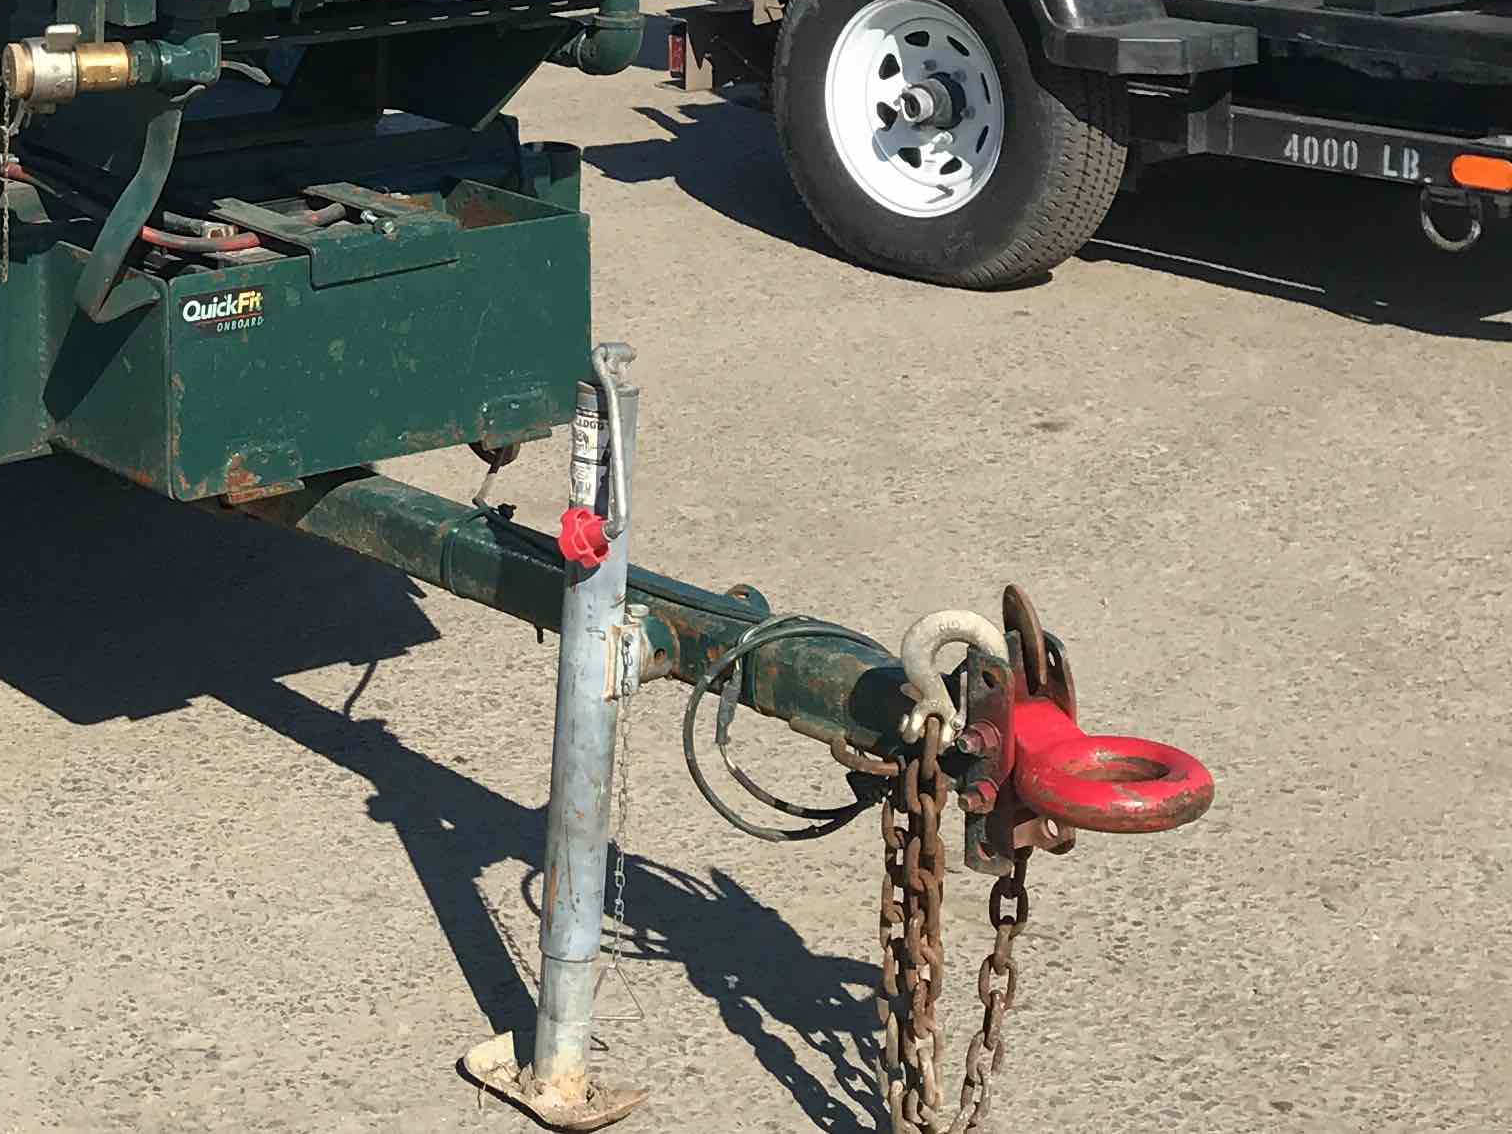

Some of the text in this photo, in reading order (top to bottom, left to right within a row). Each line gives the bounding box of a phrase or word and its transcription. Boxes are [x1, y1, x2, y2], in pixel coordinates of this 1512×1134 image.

[1284, 133, 1433, 184] 4000 LB.
[182, 290, 264, 322] QuickFit
[216, 316, 264, 333] ONBOARD
